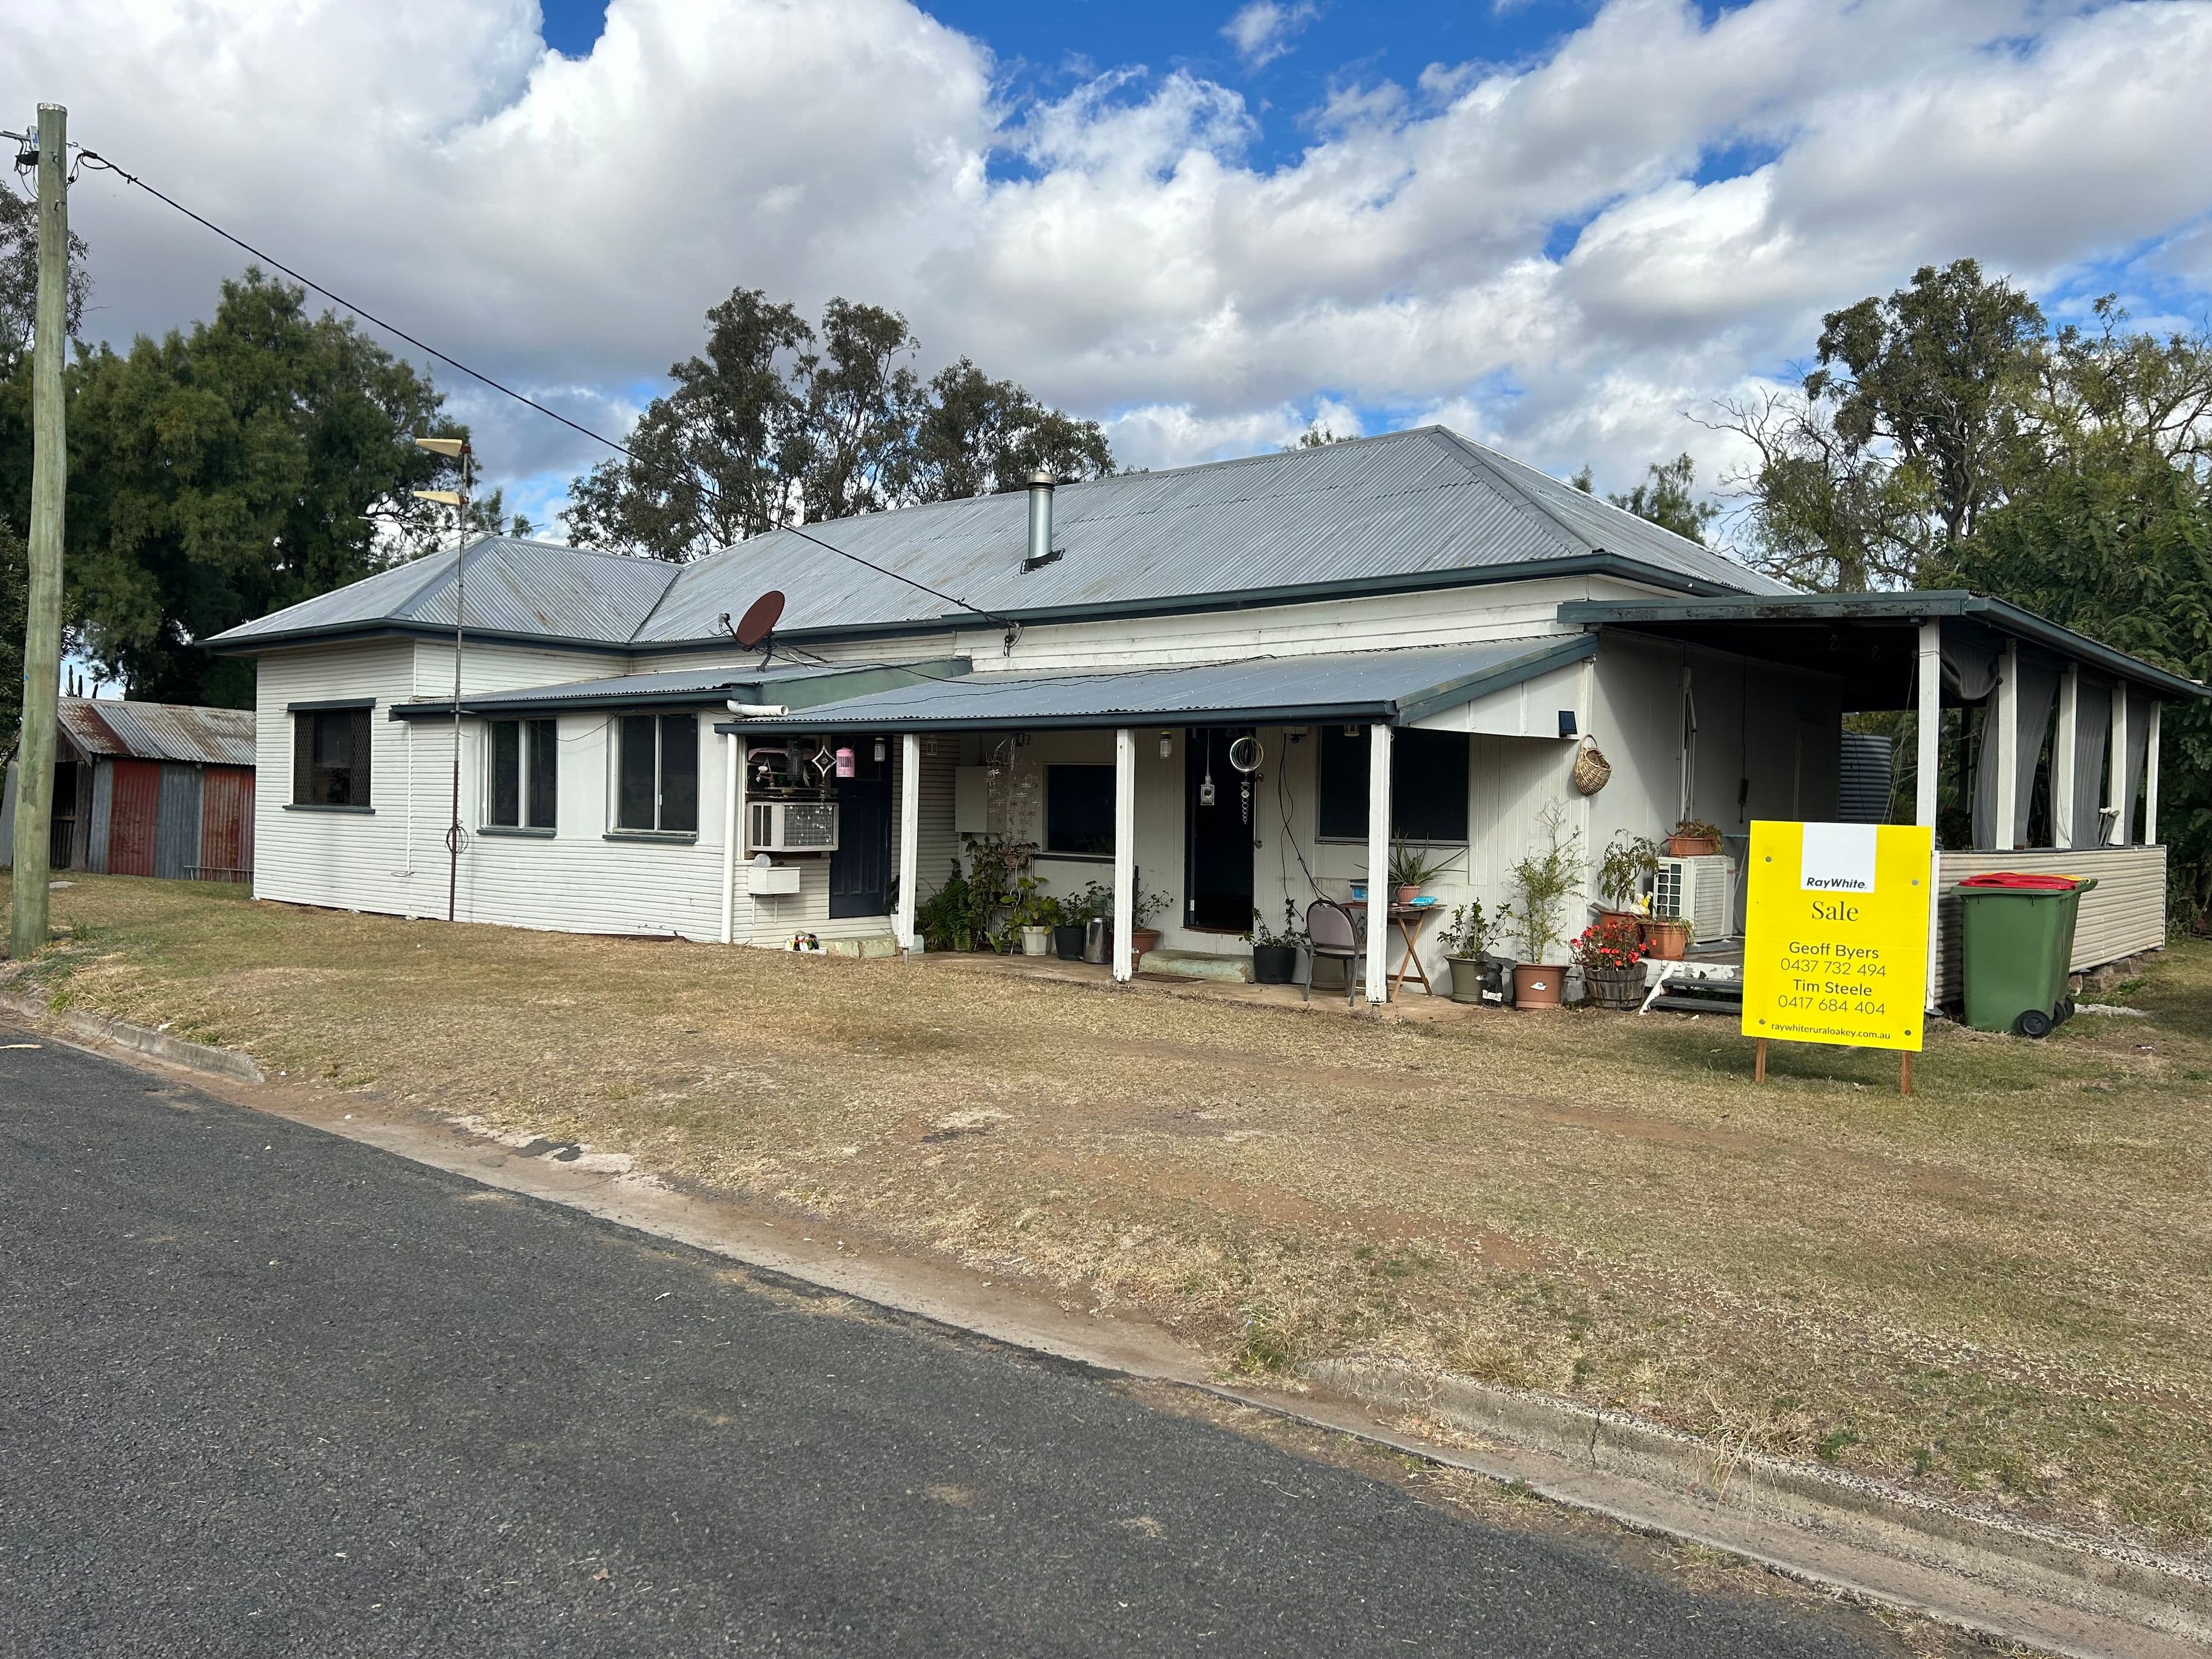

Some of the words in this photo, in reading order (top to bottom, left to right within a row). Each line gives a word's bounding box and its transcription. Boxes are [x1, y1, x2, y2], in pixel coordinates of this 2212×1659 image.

[1812, 900, 1859, 922] Sale
[1789, 941, 1831, 956] Geoff
[1835, 944, 1879, 960] Byers
[1781, 958, 1819, 972] 0437
[1824, 961, 1851, 975] 732
[1857, 964, 1886, 978] 494
[1793, 979, 1820, 993] Tim
[1824, 982, 1872, 996] Steele
[1778, 995, 1813, 1009] 0417
[1818, 998, 1848, 1013] 684
[1854, 1001, 1885, 1016] 404
[1771, 1024, 1891, 1039] raywhiteruraloakey.com.au
